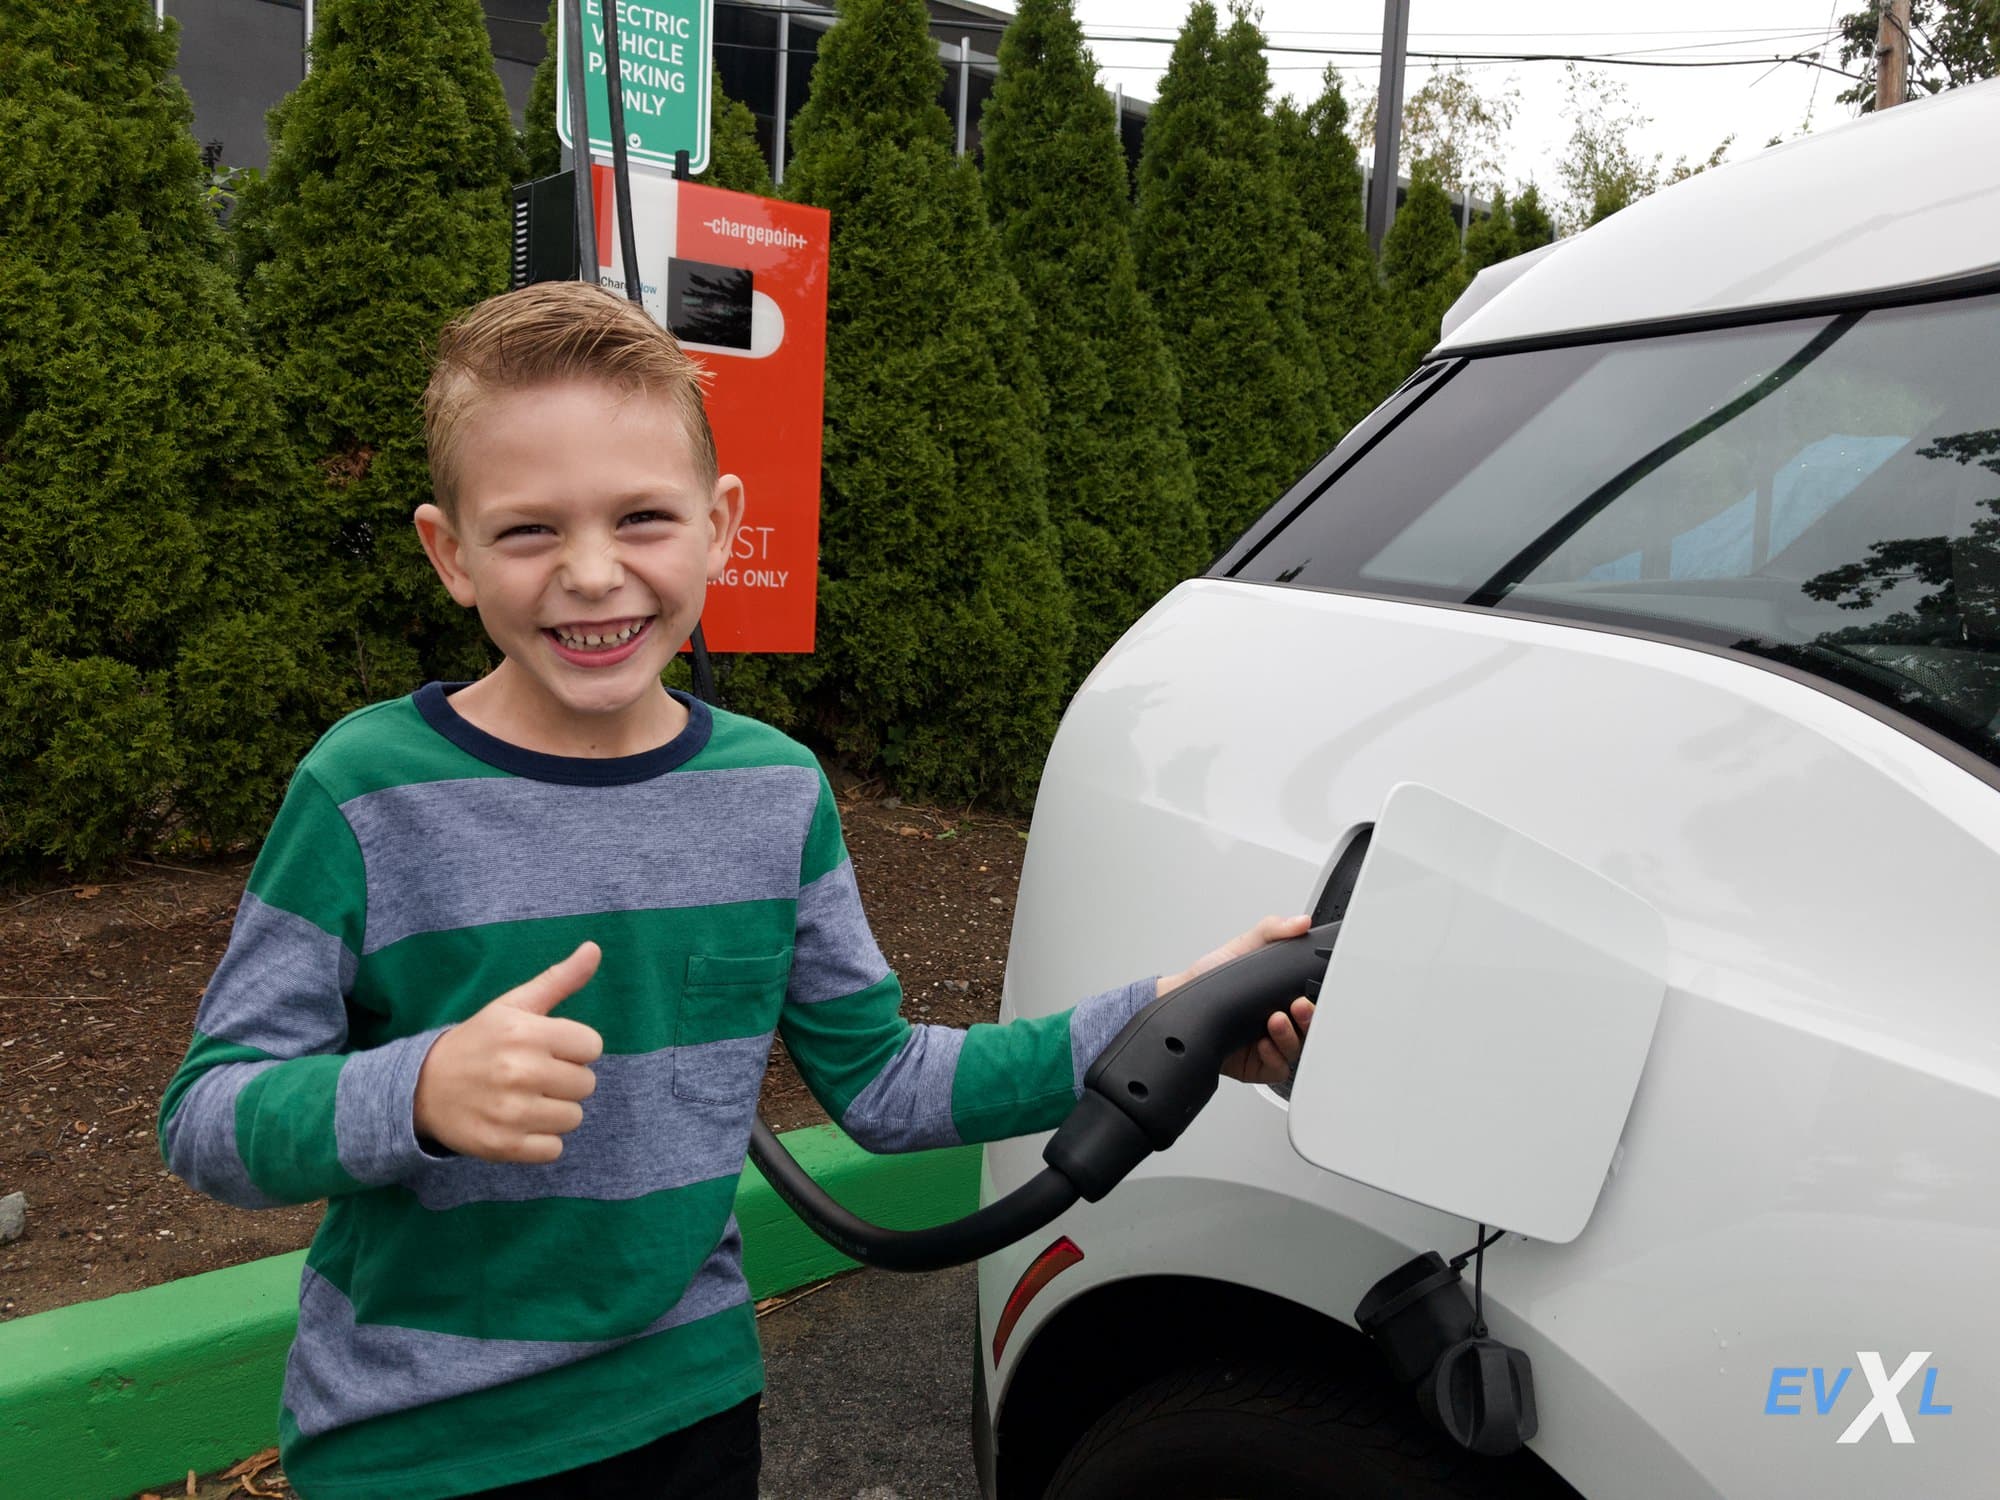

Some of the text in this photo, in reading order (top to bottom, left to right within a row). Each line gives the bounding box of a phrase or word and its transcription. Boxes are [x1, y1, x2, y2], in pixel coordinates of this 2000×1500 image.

[586, 0, 690, 39] EECTRIC
[591, 22, 684, 66] VHICLE
[621, 88, 667, 117] NLY
[730, 525, 776, 560] ST
[743, 569, 789, 588] ONLY
